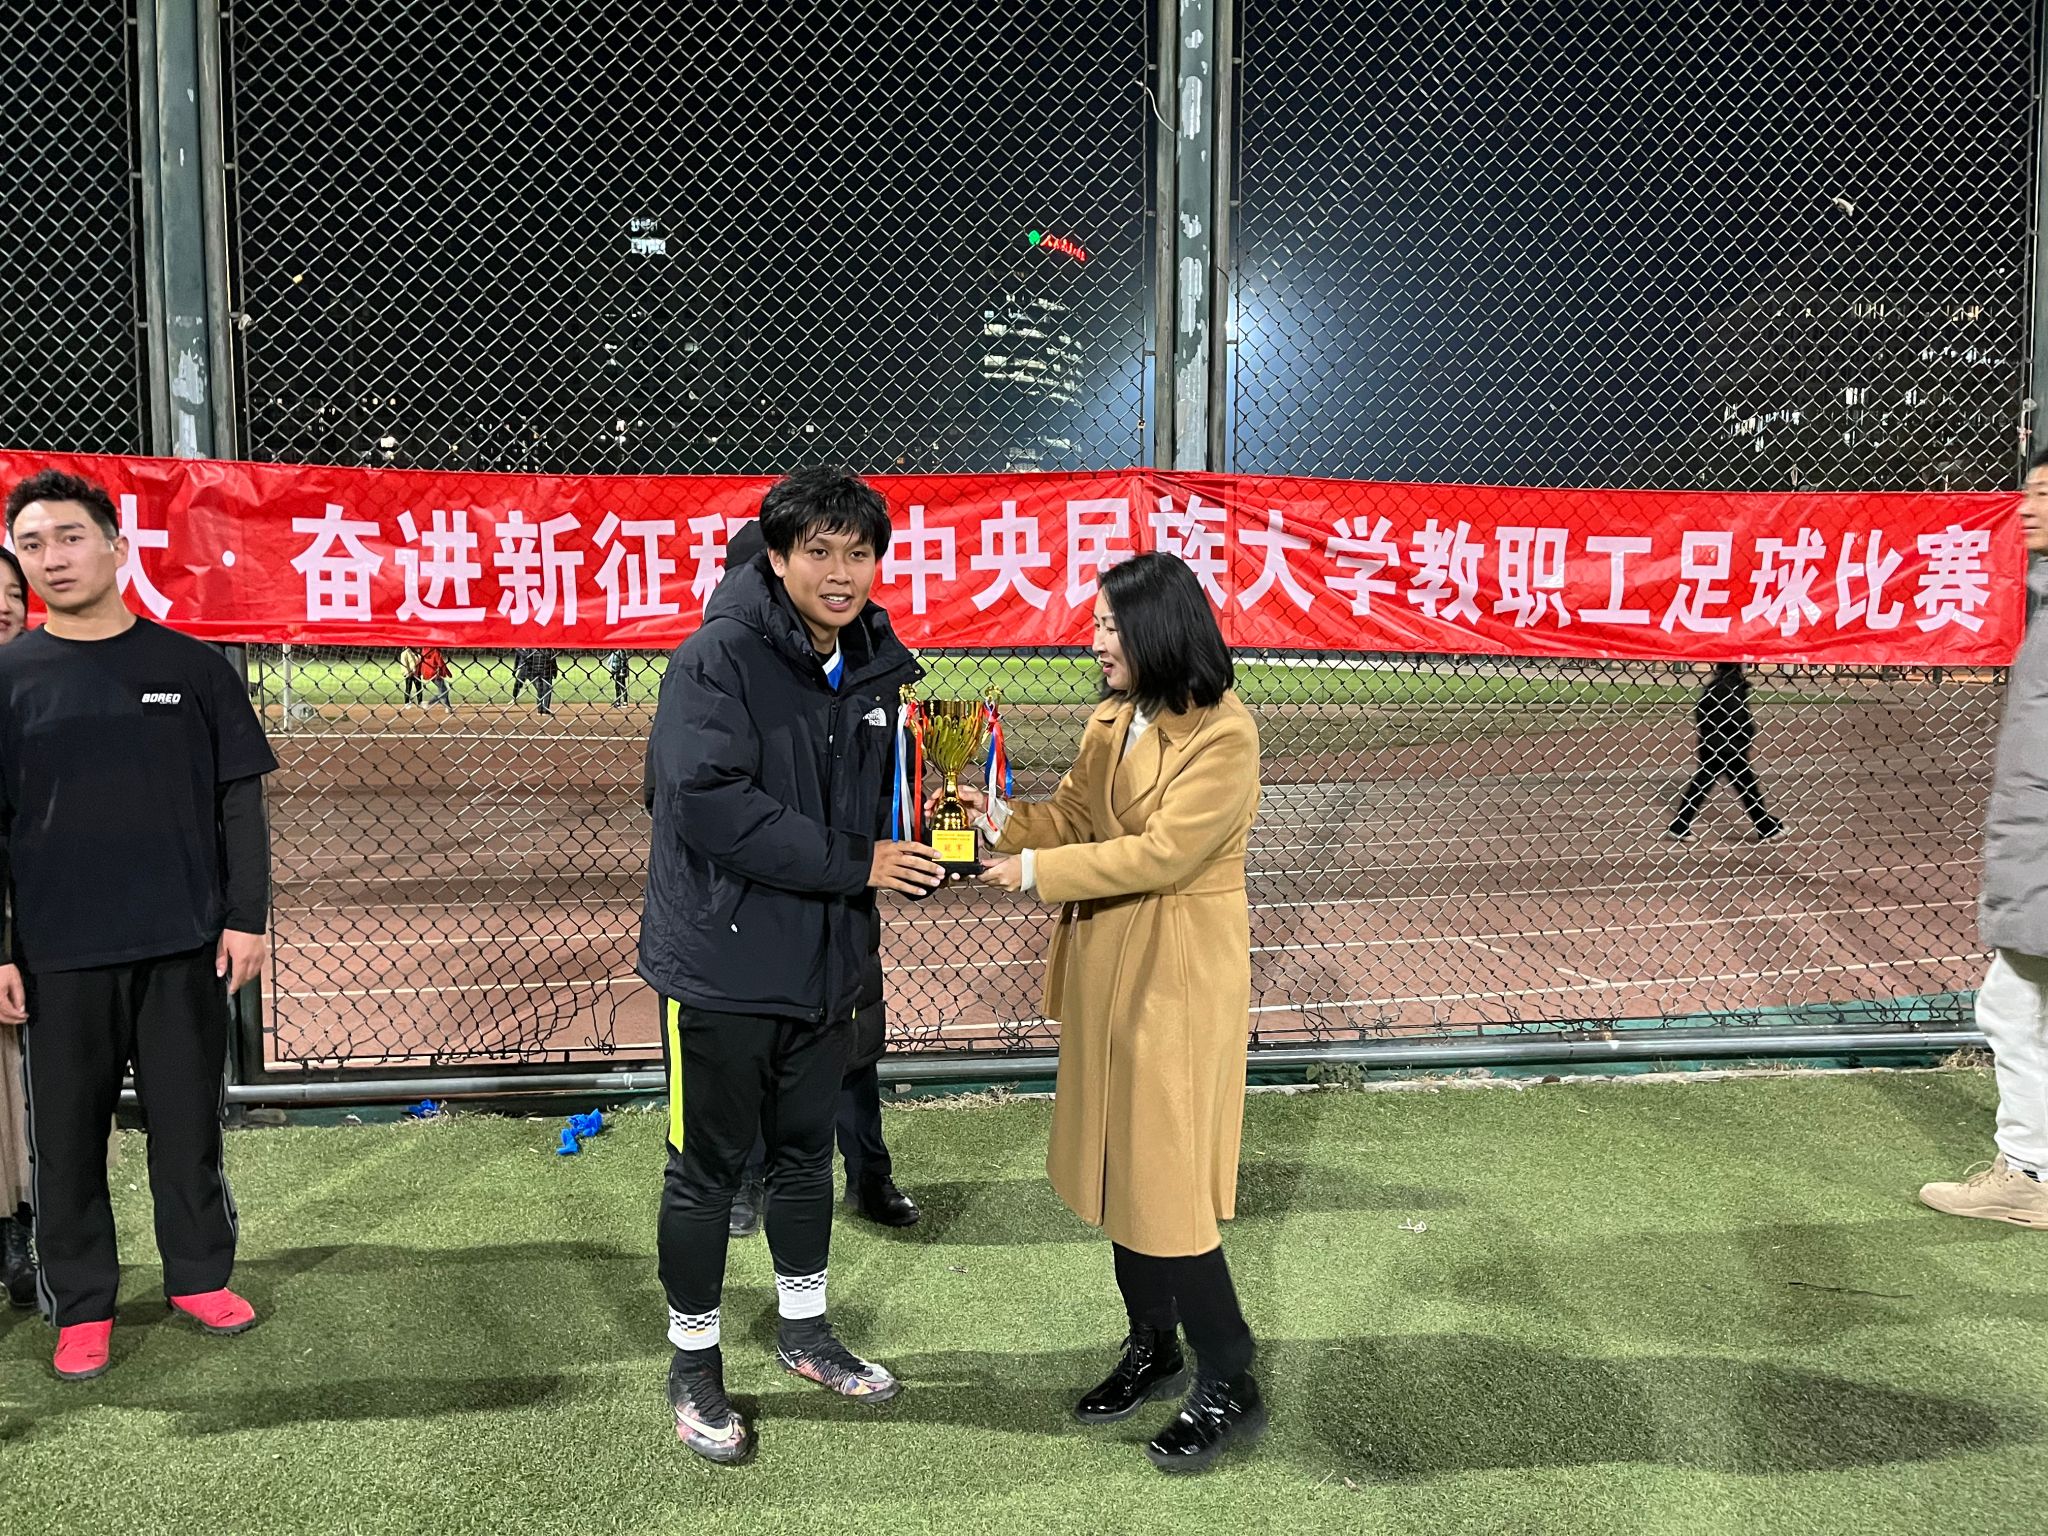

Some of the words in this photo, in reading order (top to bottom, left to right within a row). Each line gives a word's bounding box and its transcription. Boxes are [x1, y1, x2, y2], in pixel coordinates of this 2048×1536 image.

[882, 494, 1991, 638] 中央民族大学教职工足球比赛
[142, 693, 181, 703] BORED
